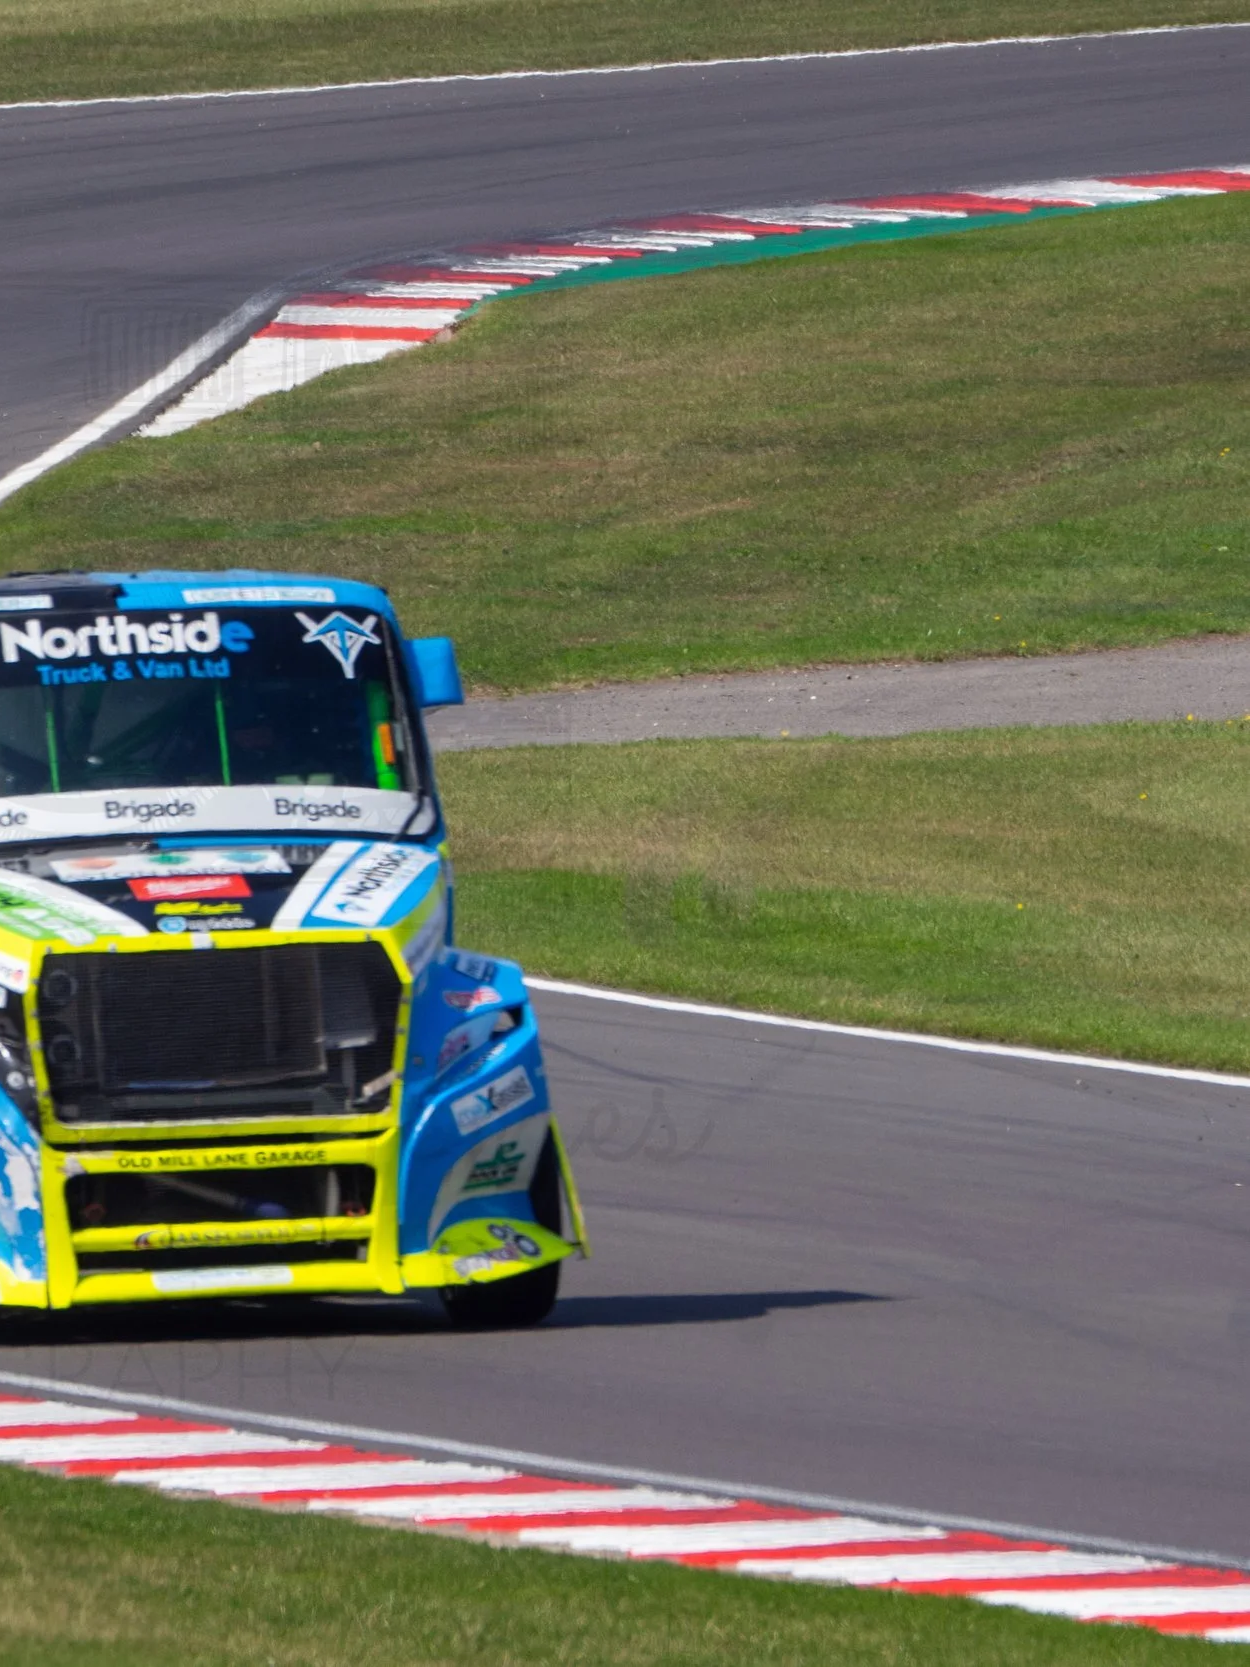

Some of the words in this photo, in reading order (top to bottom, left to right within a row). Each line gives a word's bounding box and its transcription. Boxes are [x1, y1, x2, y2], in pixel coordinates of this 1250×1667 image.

[0, 612, 255, 663] Northside
[36, 664, 107, 686] Truck
[111, 660, 132, 680] &
[136, 658, 185, 679] Van
[188, 657, 231, 678] Ltd
[104, 799, 196, 823] Brigade
[274, 798, 362, 822] Brigade
[118, 1157, 151, 1169] OLD
[158, 1155, 197, 1168] MILL
[203, 1153, 249, 1166] LANE
[254, 1150, 329, 1164] GARAGE
